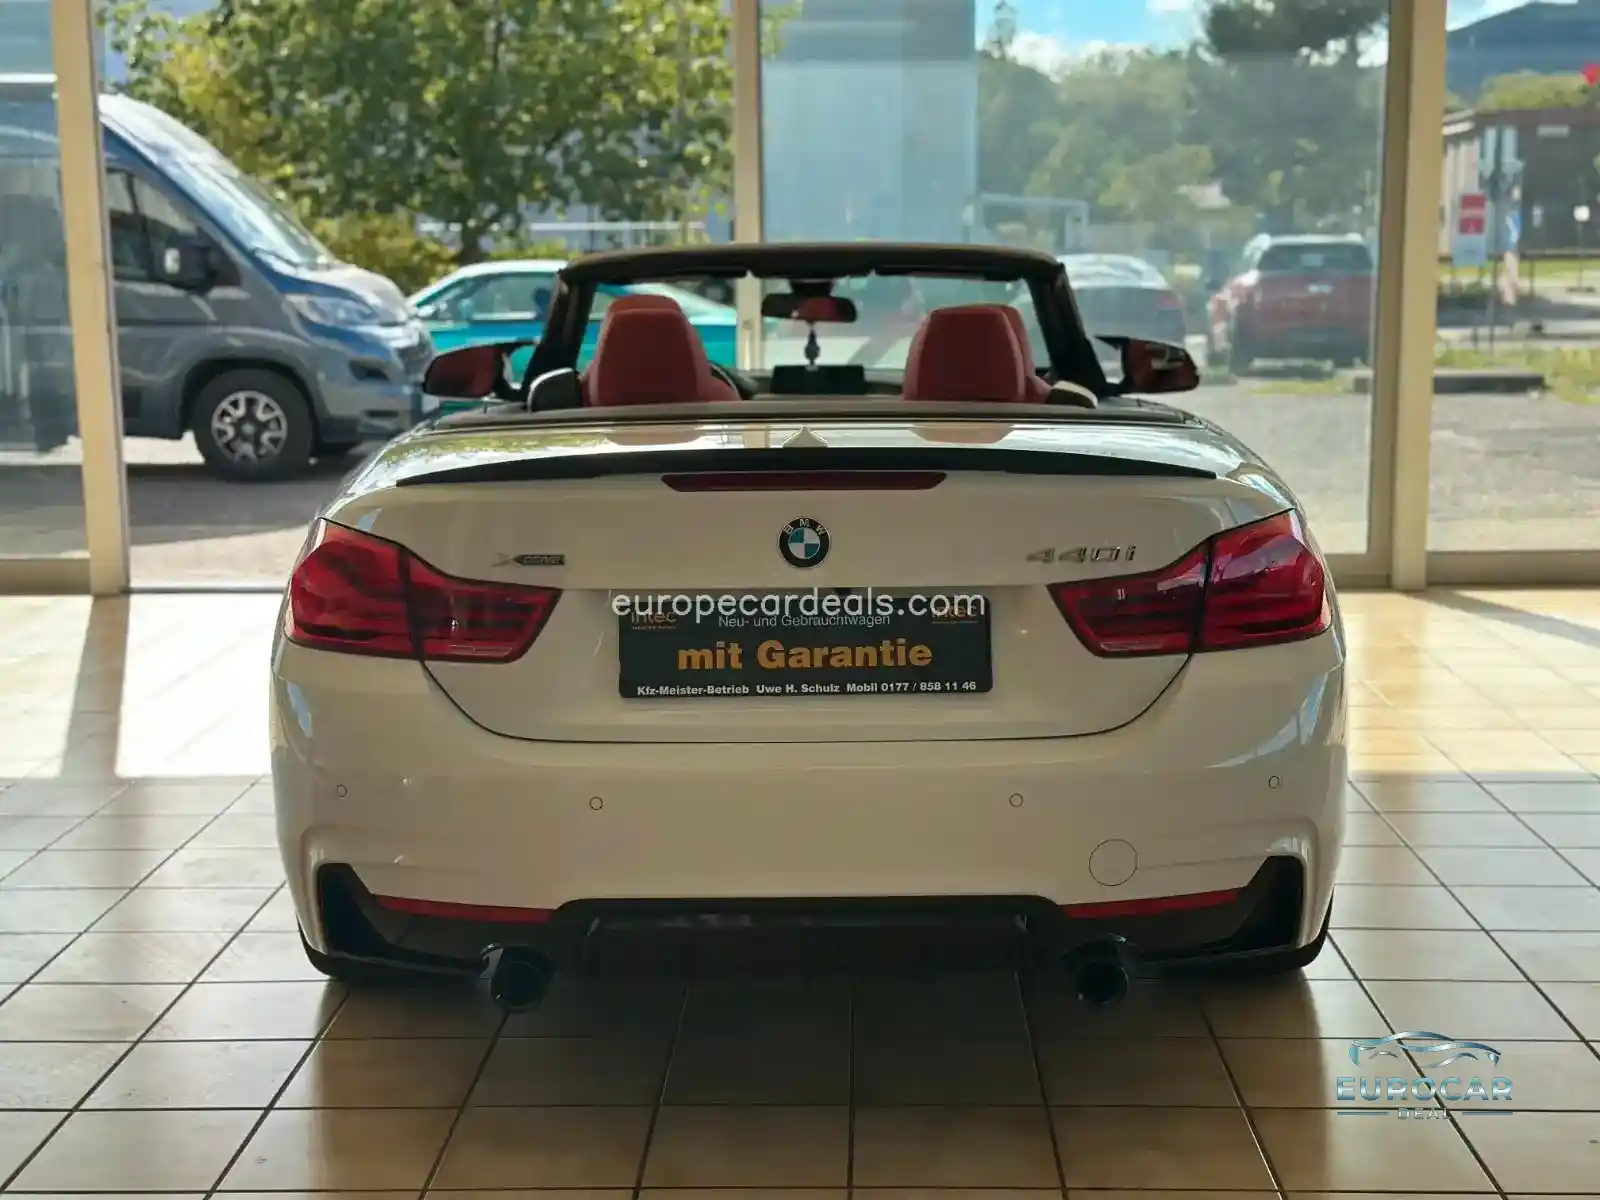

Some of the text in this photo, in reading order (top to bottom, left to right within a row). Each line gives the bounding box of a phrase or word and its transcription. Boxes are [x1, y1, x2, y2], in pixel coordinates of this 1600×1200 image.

[783, 518, 826, 536] BMW
[1026, 544, 1136, 564] 440i
[718, 613, 891, 628] Neu- und Gebrauchtwagen
[678, 637, 933, 670] mit Garantie
[637, 684, 750, 696] Kfz-Meister-Betrieb
[756, 684, 782, 694] Uwe
[785, 683, 798, 694] H.
[801, 683, 840, 694] Schulz
[846, 682, 878, 693] Mobil
[881, 682, 909, 692] 0177
[920, 681, 942, 692] 858
[945, 681, 958, 691] 11
[962, 681, 977, 691] 46
